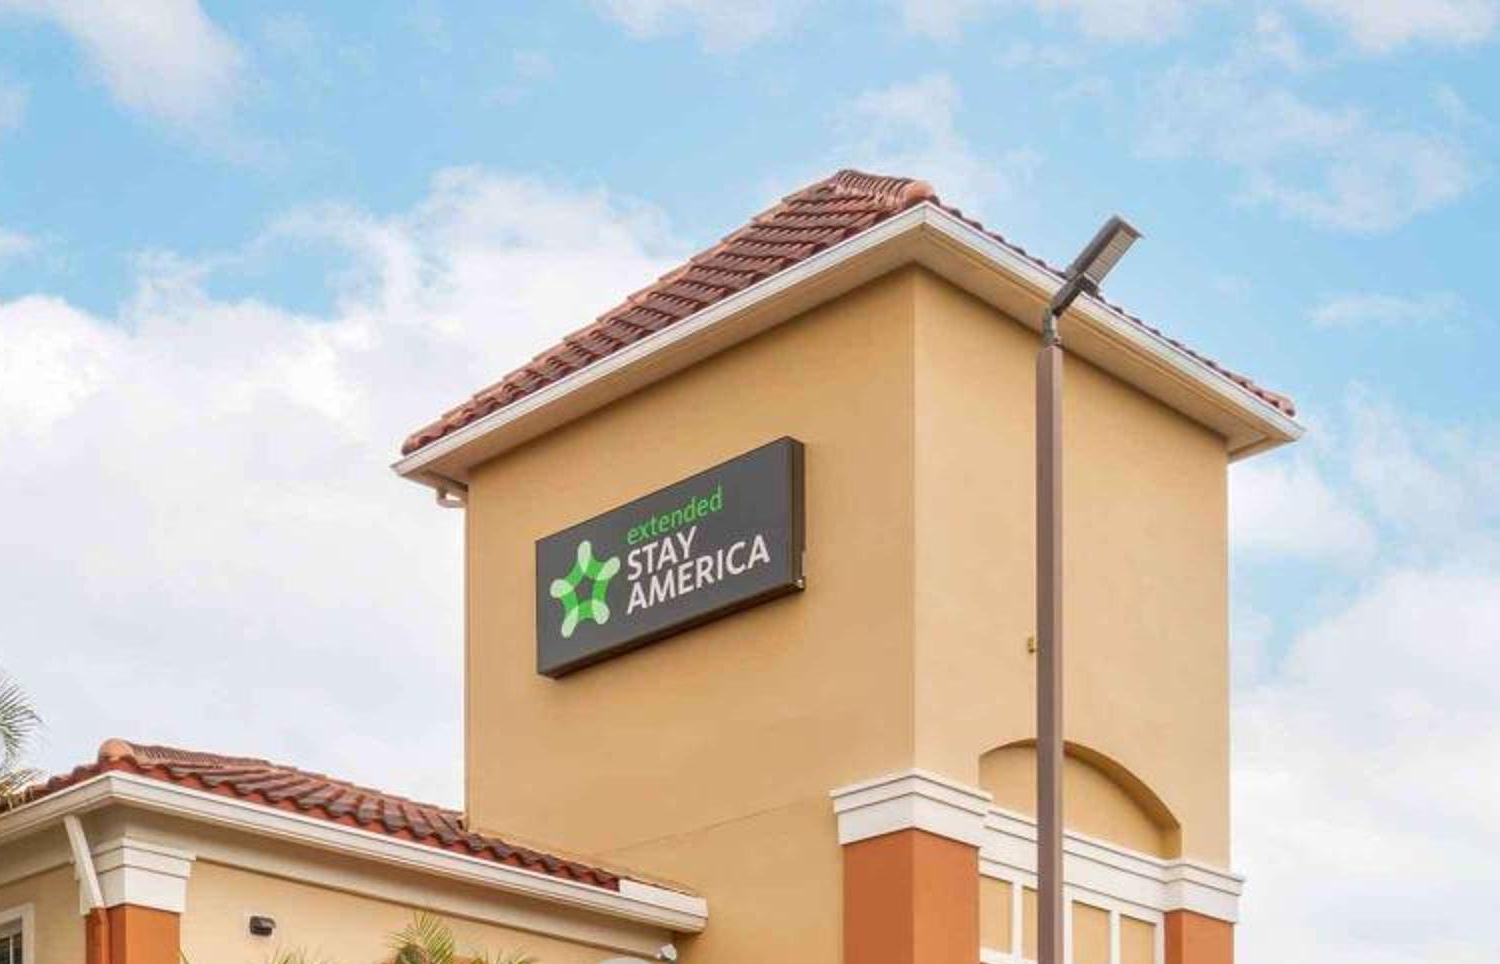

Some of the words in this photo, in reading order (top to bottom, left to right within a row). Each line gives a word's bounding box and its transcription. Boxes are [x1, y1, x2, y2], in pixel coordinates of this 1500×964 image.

[627, 484, 723, 545] extended
[627, 525, 697, 581] STAY
[627, 535, 771, 614] AMERICA
